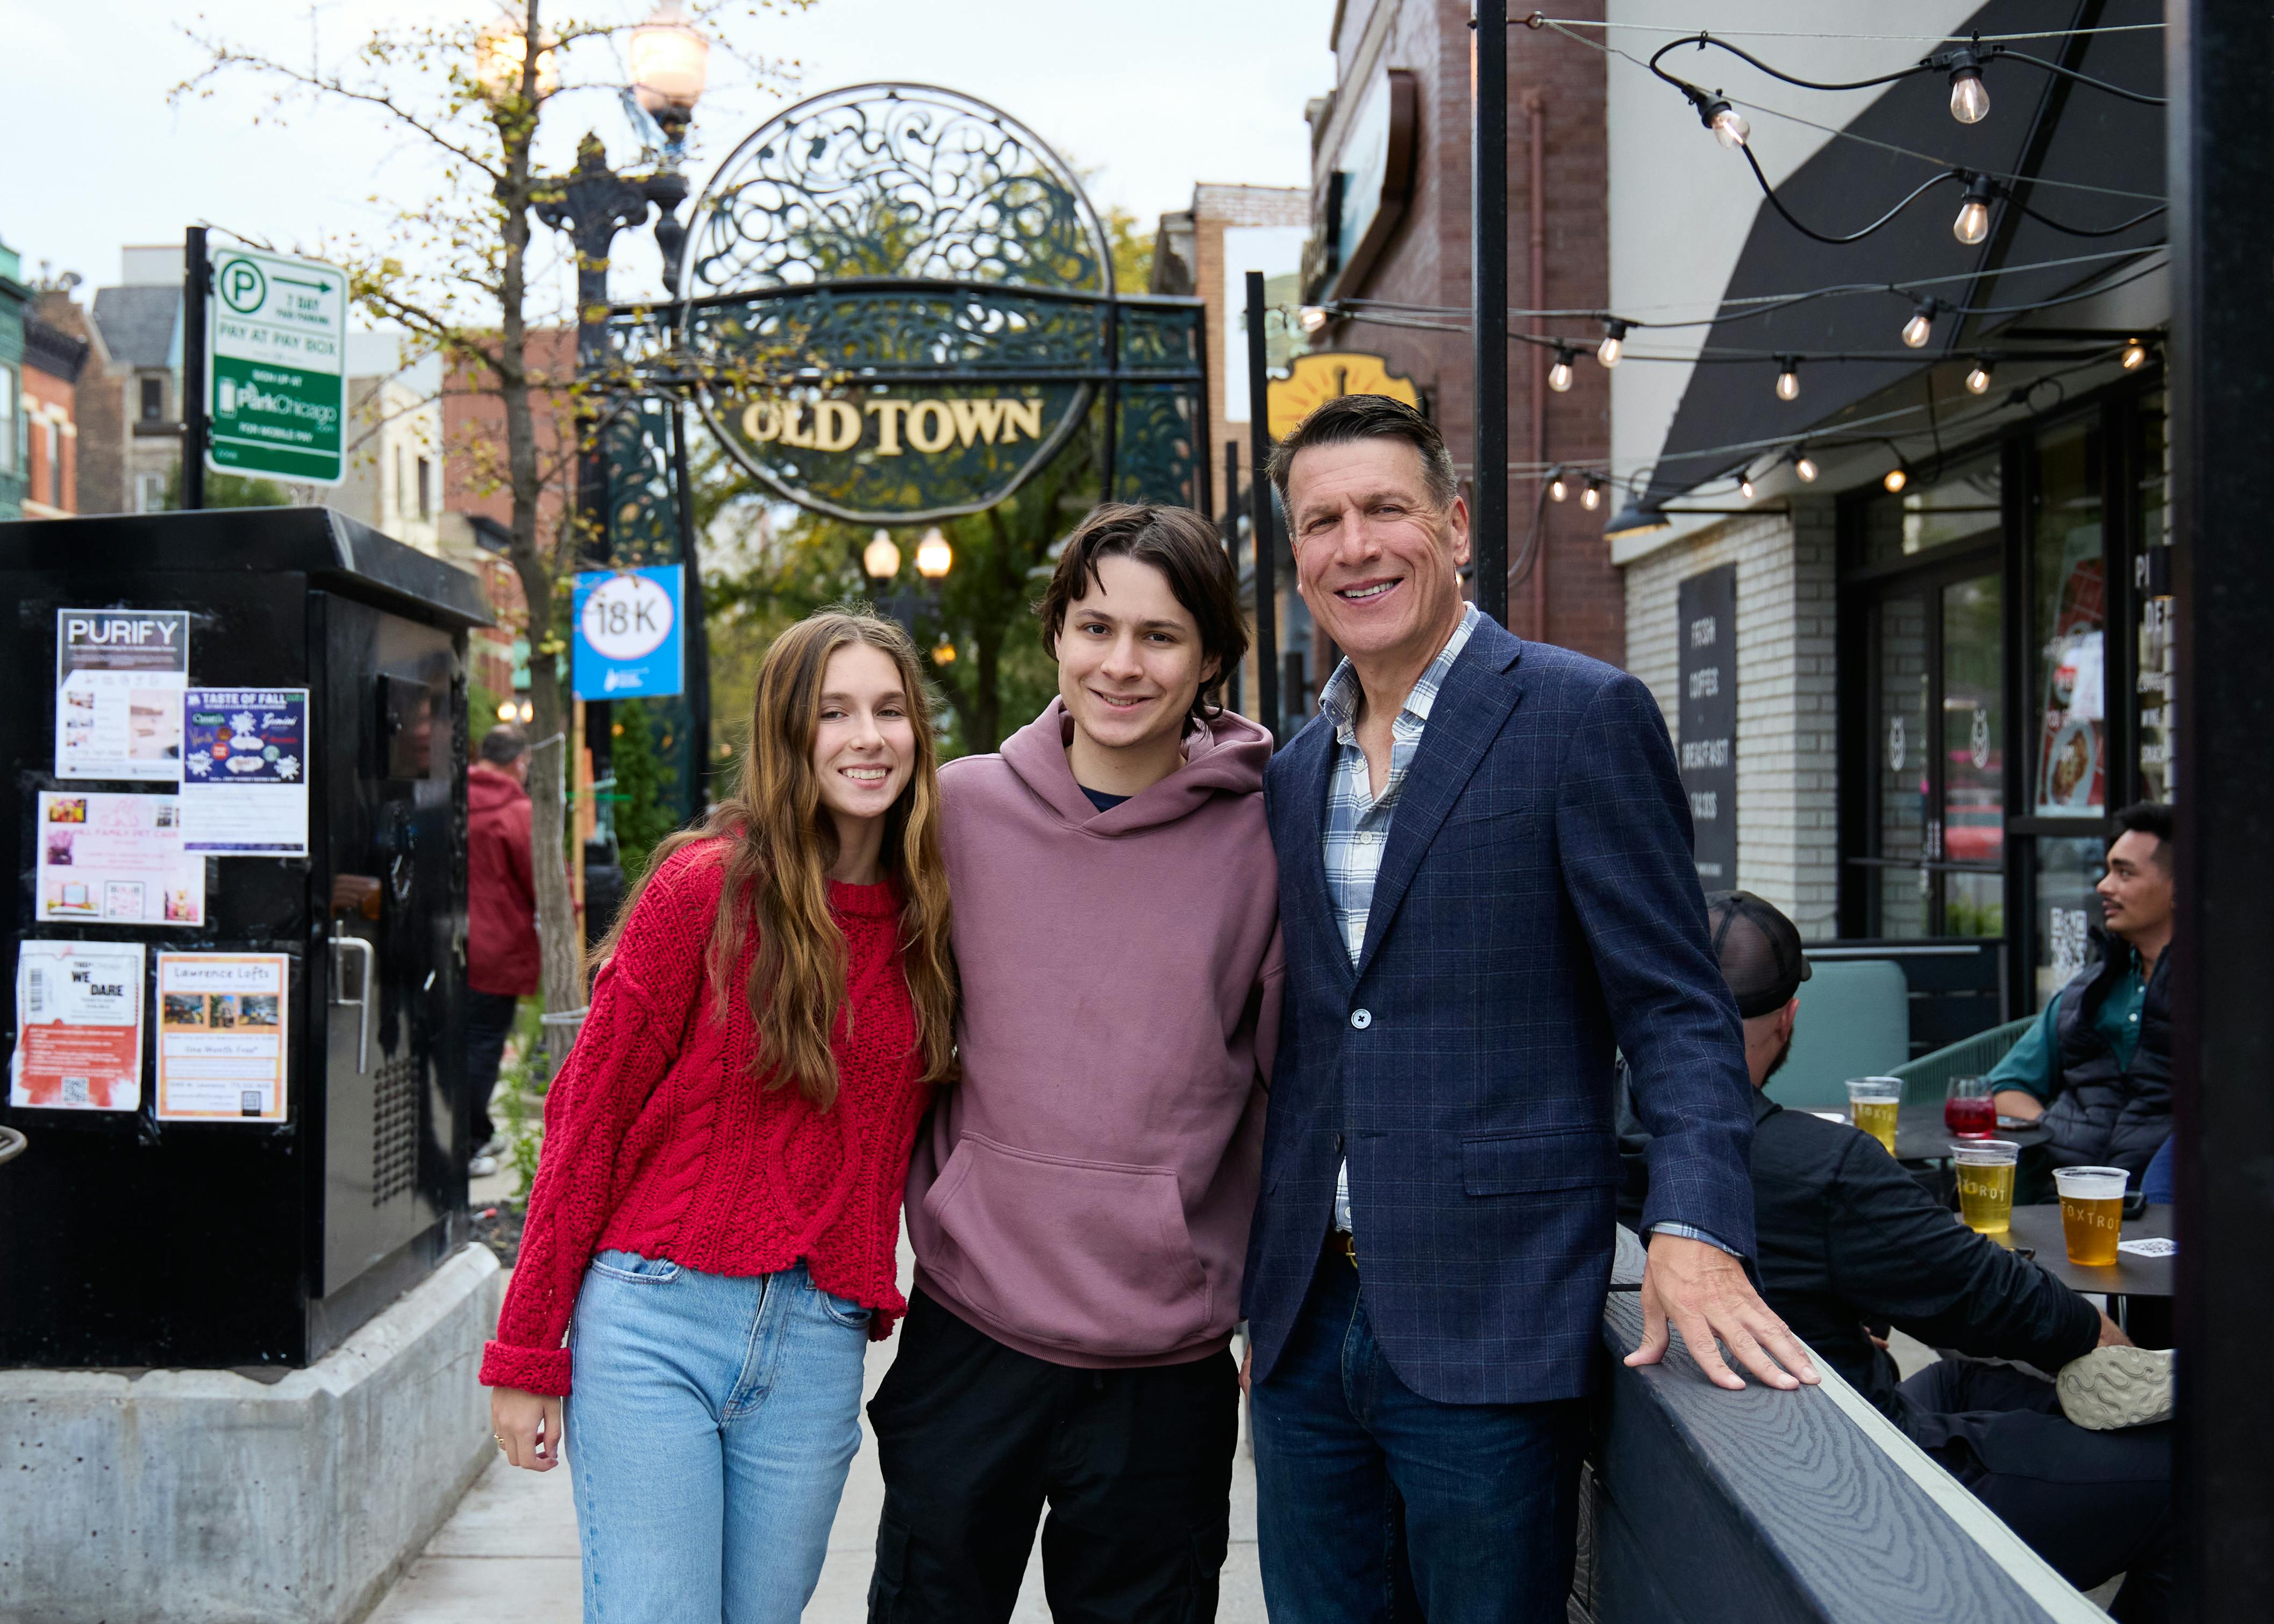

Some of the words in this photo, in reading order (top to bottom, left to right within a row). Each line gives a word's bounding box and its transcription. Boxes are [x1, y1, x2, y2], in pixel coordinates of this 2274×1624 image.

[234, 269, 255, 301] P
[219, 323, 246, 338] PAY
[251, 328, 267, 343] AT
[273, 331, 300, 348] PAY
[304, 338, 336, 354] BOX
[237, 386, 338, 425] ParkChicago
[238, 422, 258, 435] FOR
[295, 430, 313, 443] PAY
[742, 399, 862, 452] OLD
[864, 399, 1044, 456] TOWN
[597, 598, 657, 635] 18K
[68, 619, 179, 645] PURIFY
[1691, 616, 1716, 649] FRESH
[1689, 667, 1720, 699] COFFEE
[202, 693, 240, 704] TASTE
[240, 693, 258, 704] OF
[258, 693, 288, 705] FALL
[1681, 738, 1729, 771] BREAKFAST
[1691, 790, 1717, 820] TACOS
[72, 971, 90, 983] WE
[174, 966, 233, 978] Lawrence
[238, 966, 270, 980] Lofts
[90, 985, 124, 996] DARE
[2061, 1200, 2120, 1230] FOXTROT
